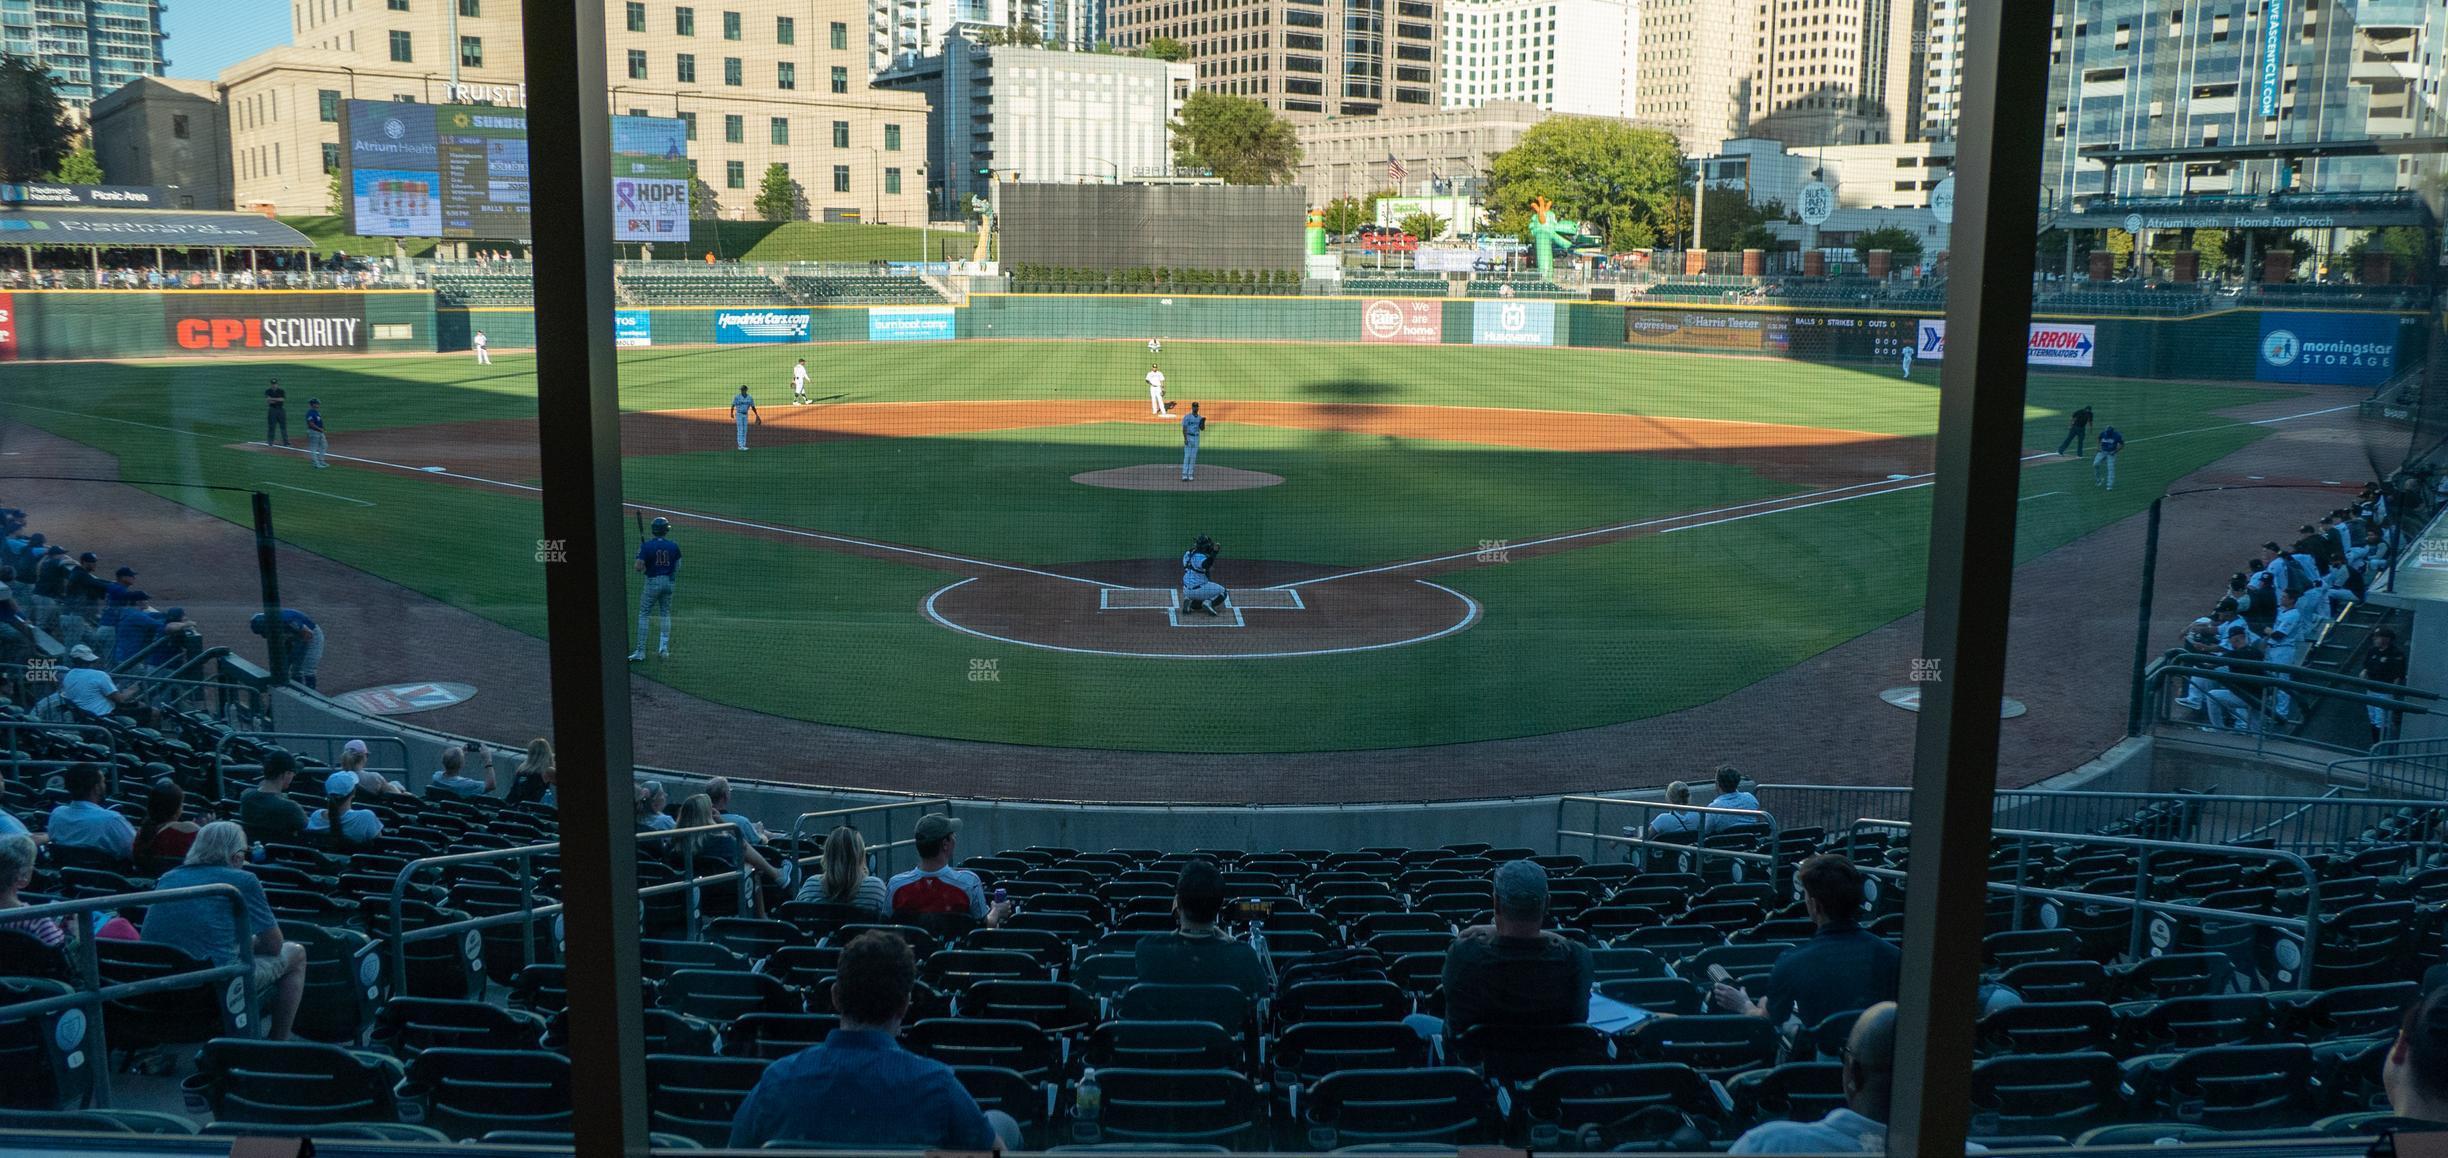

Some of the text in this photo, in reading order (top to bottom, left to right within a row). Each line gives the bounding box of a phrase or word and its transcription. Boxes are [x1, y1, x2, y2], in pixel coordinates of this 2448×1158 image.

[443, 83, 515, 102] TRUIST
[354, 140, 437, 154] Atrium Health
[91, 190, 149, 202] Picnic Area
[637, 183, 685, 202] HOPE
[2146, 217, 2183, 228] Atrium
[2235, 216, 2334, 227] Home Run Porch
[1412, 303, 1430, 312] We
[1412, 316, 1428, 324] are
[1695, 315, 1725, 328] Harris
[1727, 317, 1760, 328] Teeter
[1796, 317, 1815, 325] BALLS
[1827, 319, 1854, 327] STRIKES
[176, 317, 356, 349] CPI SECURITY
[2029, 331, 2081, 349] ARROW
[2302, 340, 2393, 356] morningstar
[2303, 354, 2391, 367] STORAGE
[656, 550, 670, 567] 11
